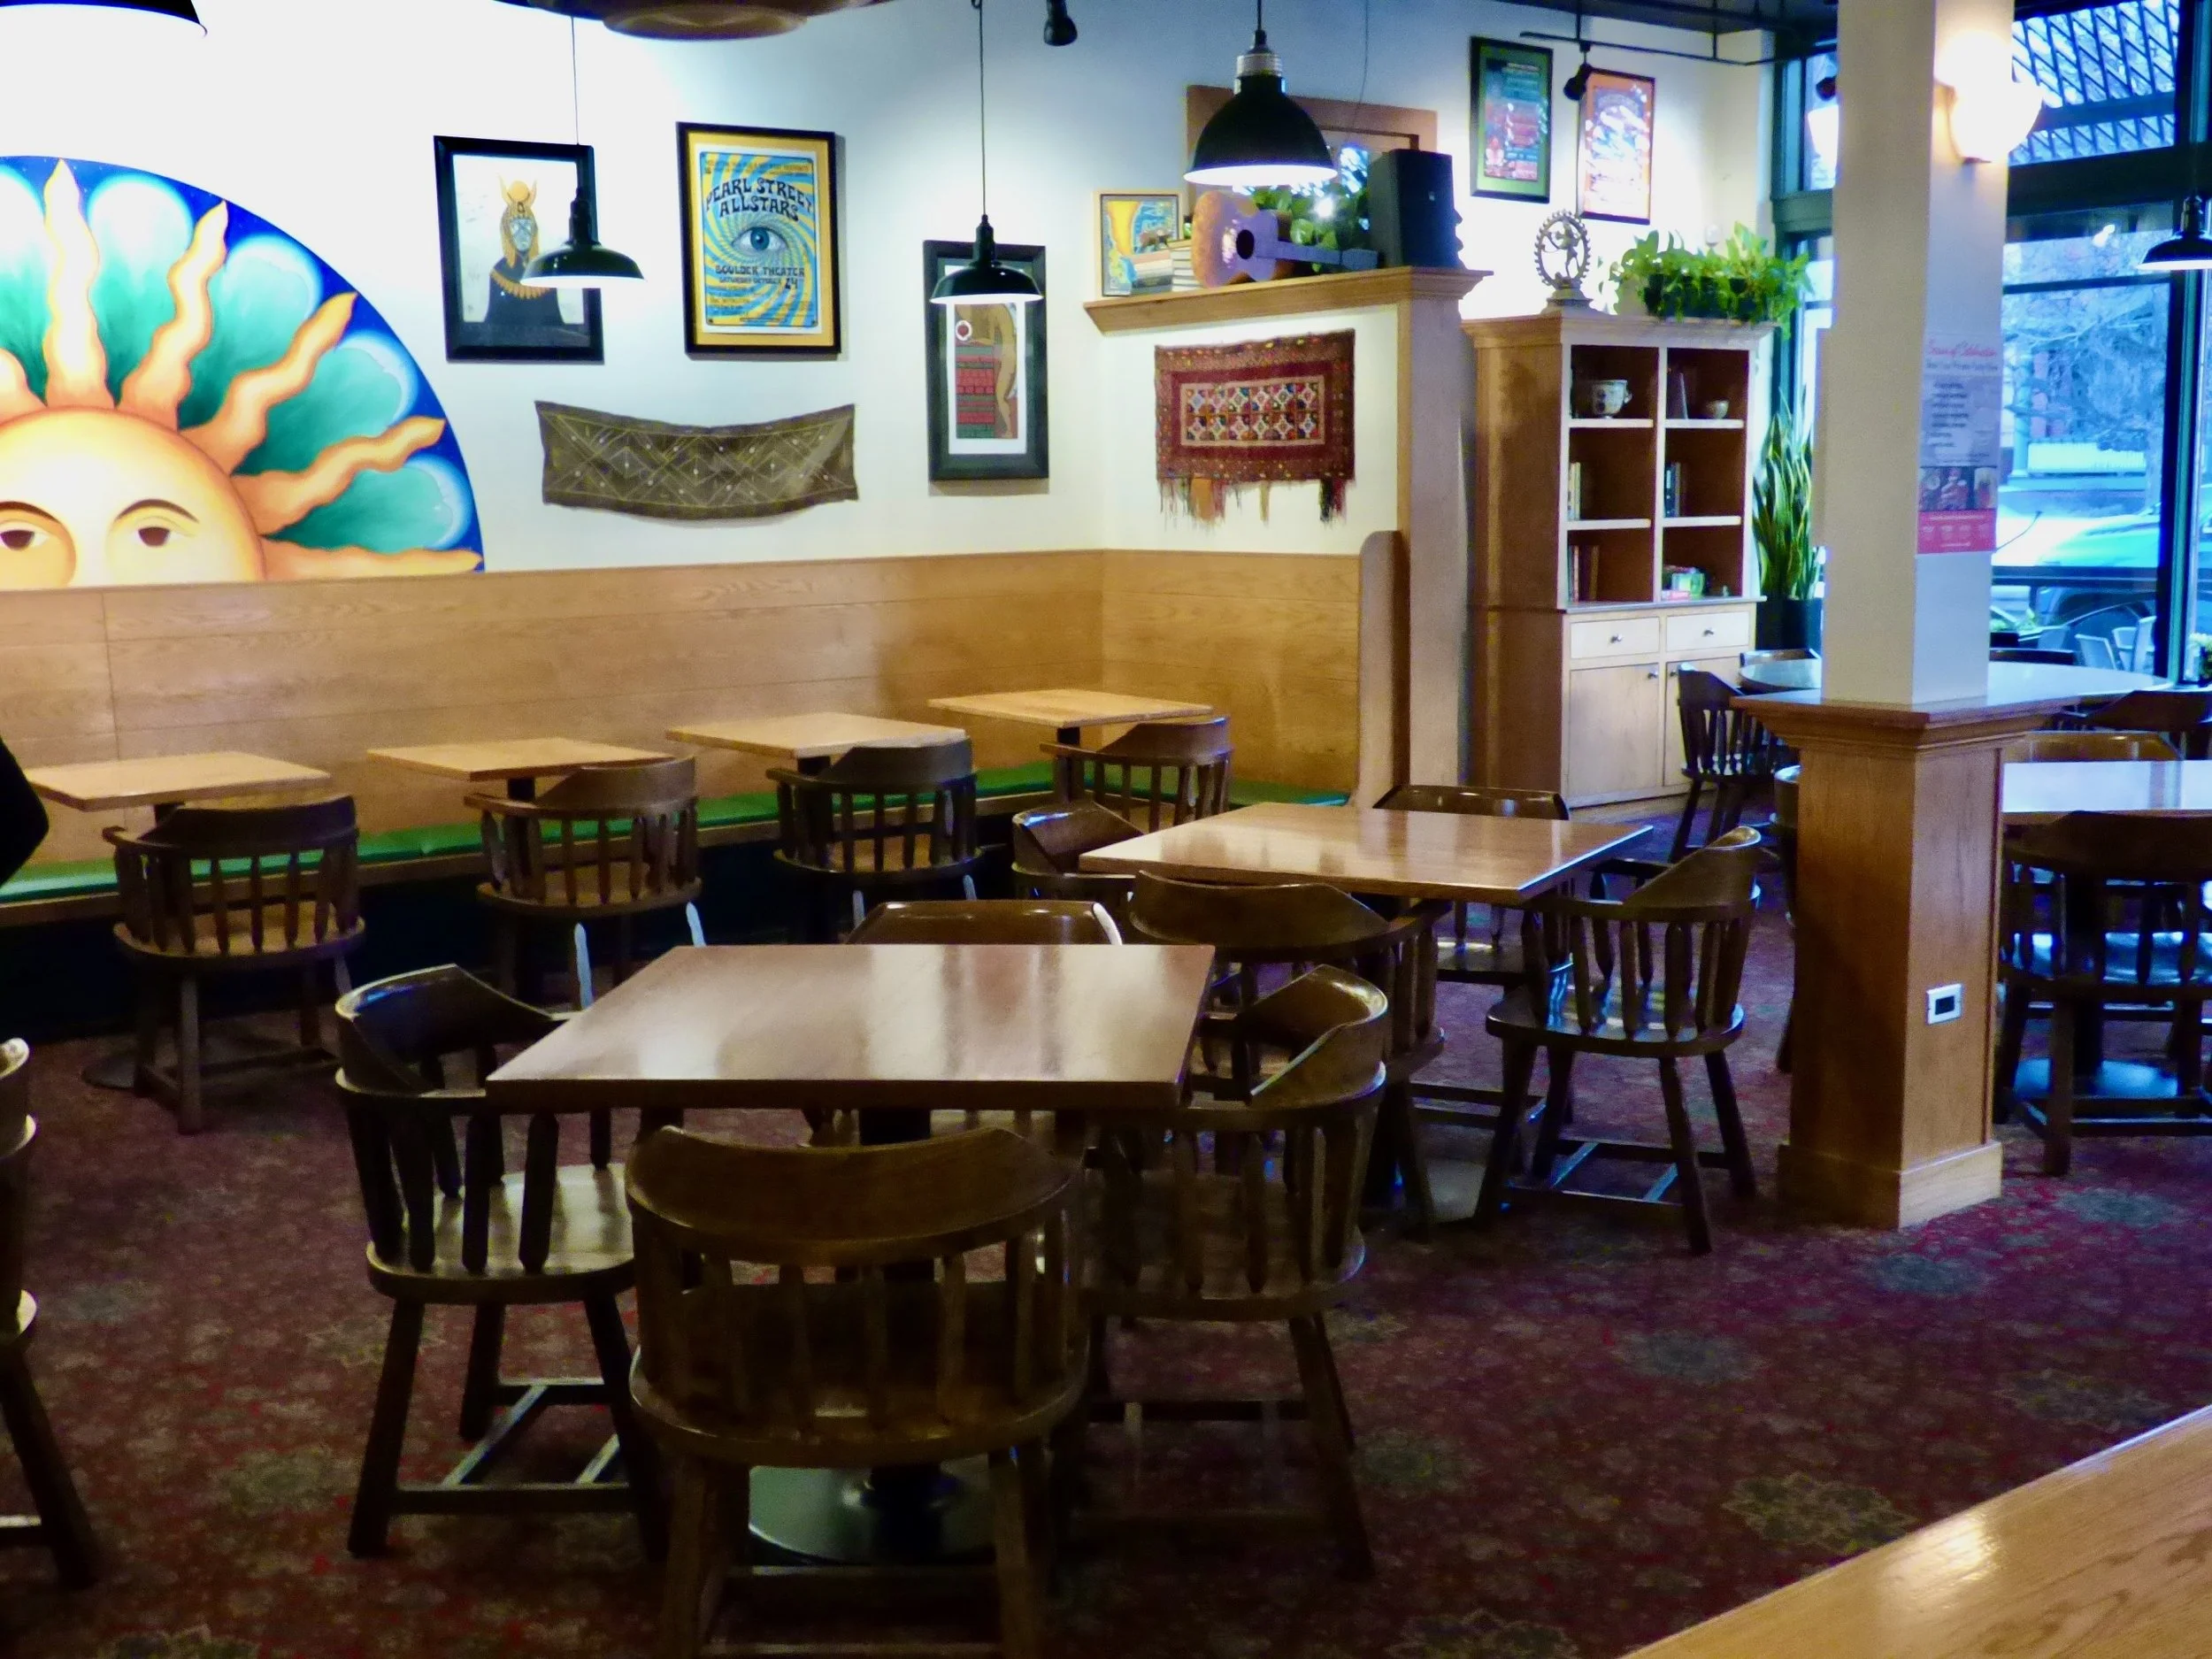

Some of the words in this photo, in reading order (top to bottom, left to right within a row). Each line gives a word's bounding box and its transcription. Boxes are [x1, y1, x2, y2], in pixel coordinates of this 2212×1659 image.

[706, 177, 751, 211] PEARL
[757, 177, 812, 212] STREET
[719, 195, 799, 221] ALLSTARS
[715, 265, 758, 275] BOULDER
[763, 266, 805, 276] THEATER
